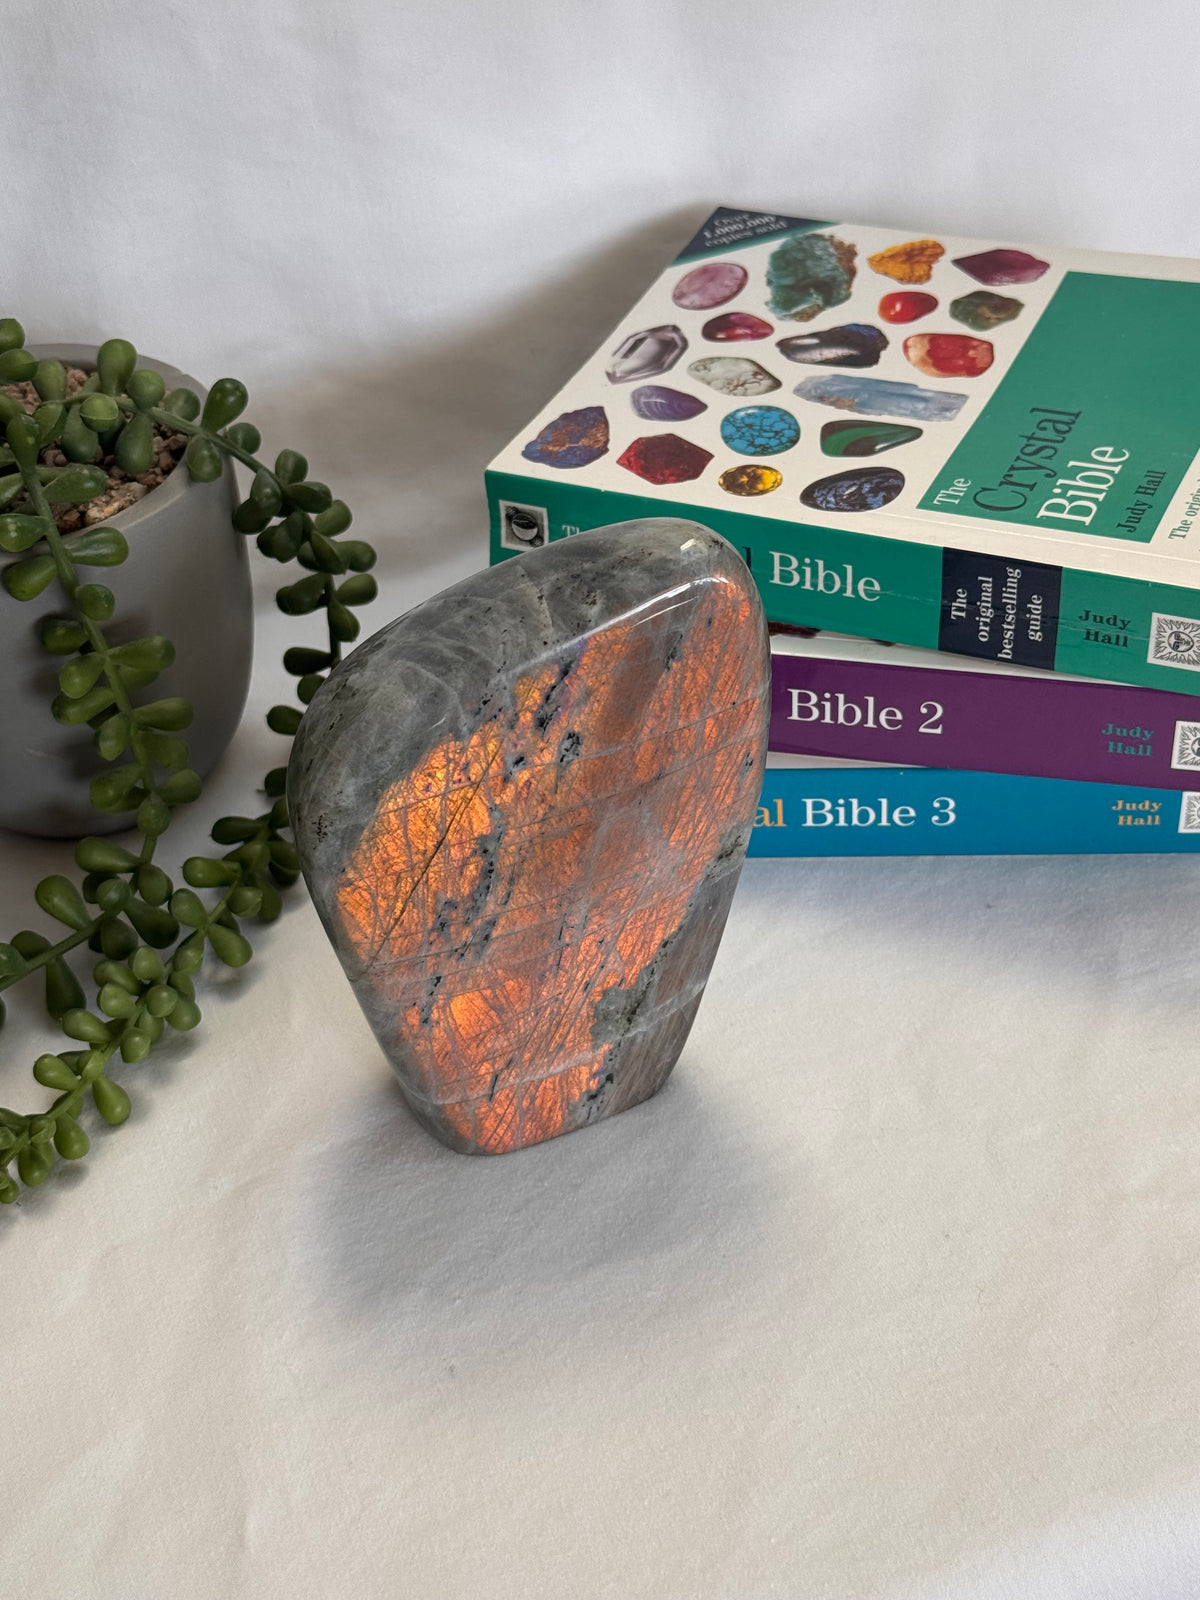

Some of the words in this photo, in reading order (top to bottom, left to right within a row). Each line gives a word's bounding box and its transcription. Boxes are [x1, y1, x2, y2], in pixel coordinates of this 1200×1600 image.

[972, 407, 1083, 512] Crystal
[933, 477, 972, 505] The
[1036, 446, 1130, 526] Bible
[1134, 470, 1167, 497] Hall
[1116, 500, 1153, 533] Judy
[1168, 519, 1193, 540] The
[769, 551, 881, 602] Bible
[950, 588, 968, 620] The
[976, 575, 994, 642] original
[998, 567, 1022, 660] bestselling
[1026, 594, 1043, 642] guide
[1078, 609, 1131, 631] Judy
[1084, 628, 1129, 648] Hall
[787, 688, 903, 731] Bible
[918, 701, 944, 734] 2
[1101, 723, 1154, 741] Judy
[1107, 741, 1152, 757] Hall
[801, 798, 916, 827] Bible
[931, 796, 957, 827] 3
[1111, 800, 1162, 812] Judy
[1118, 815, 1161, 826] Hall
